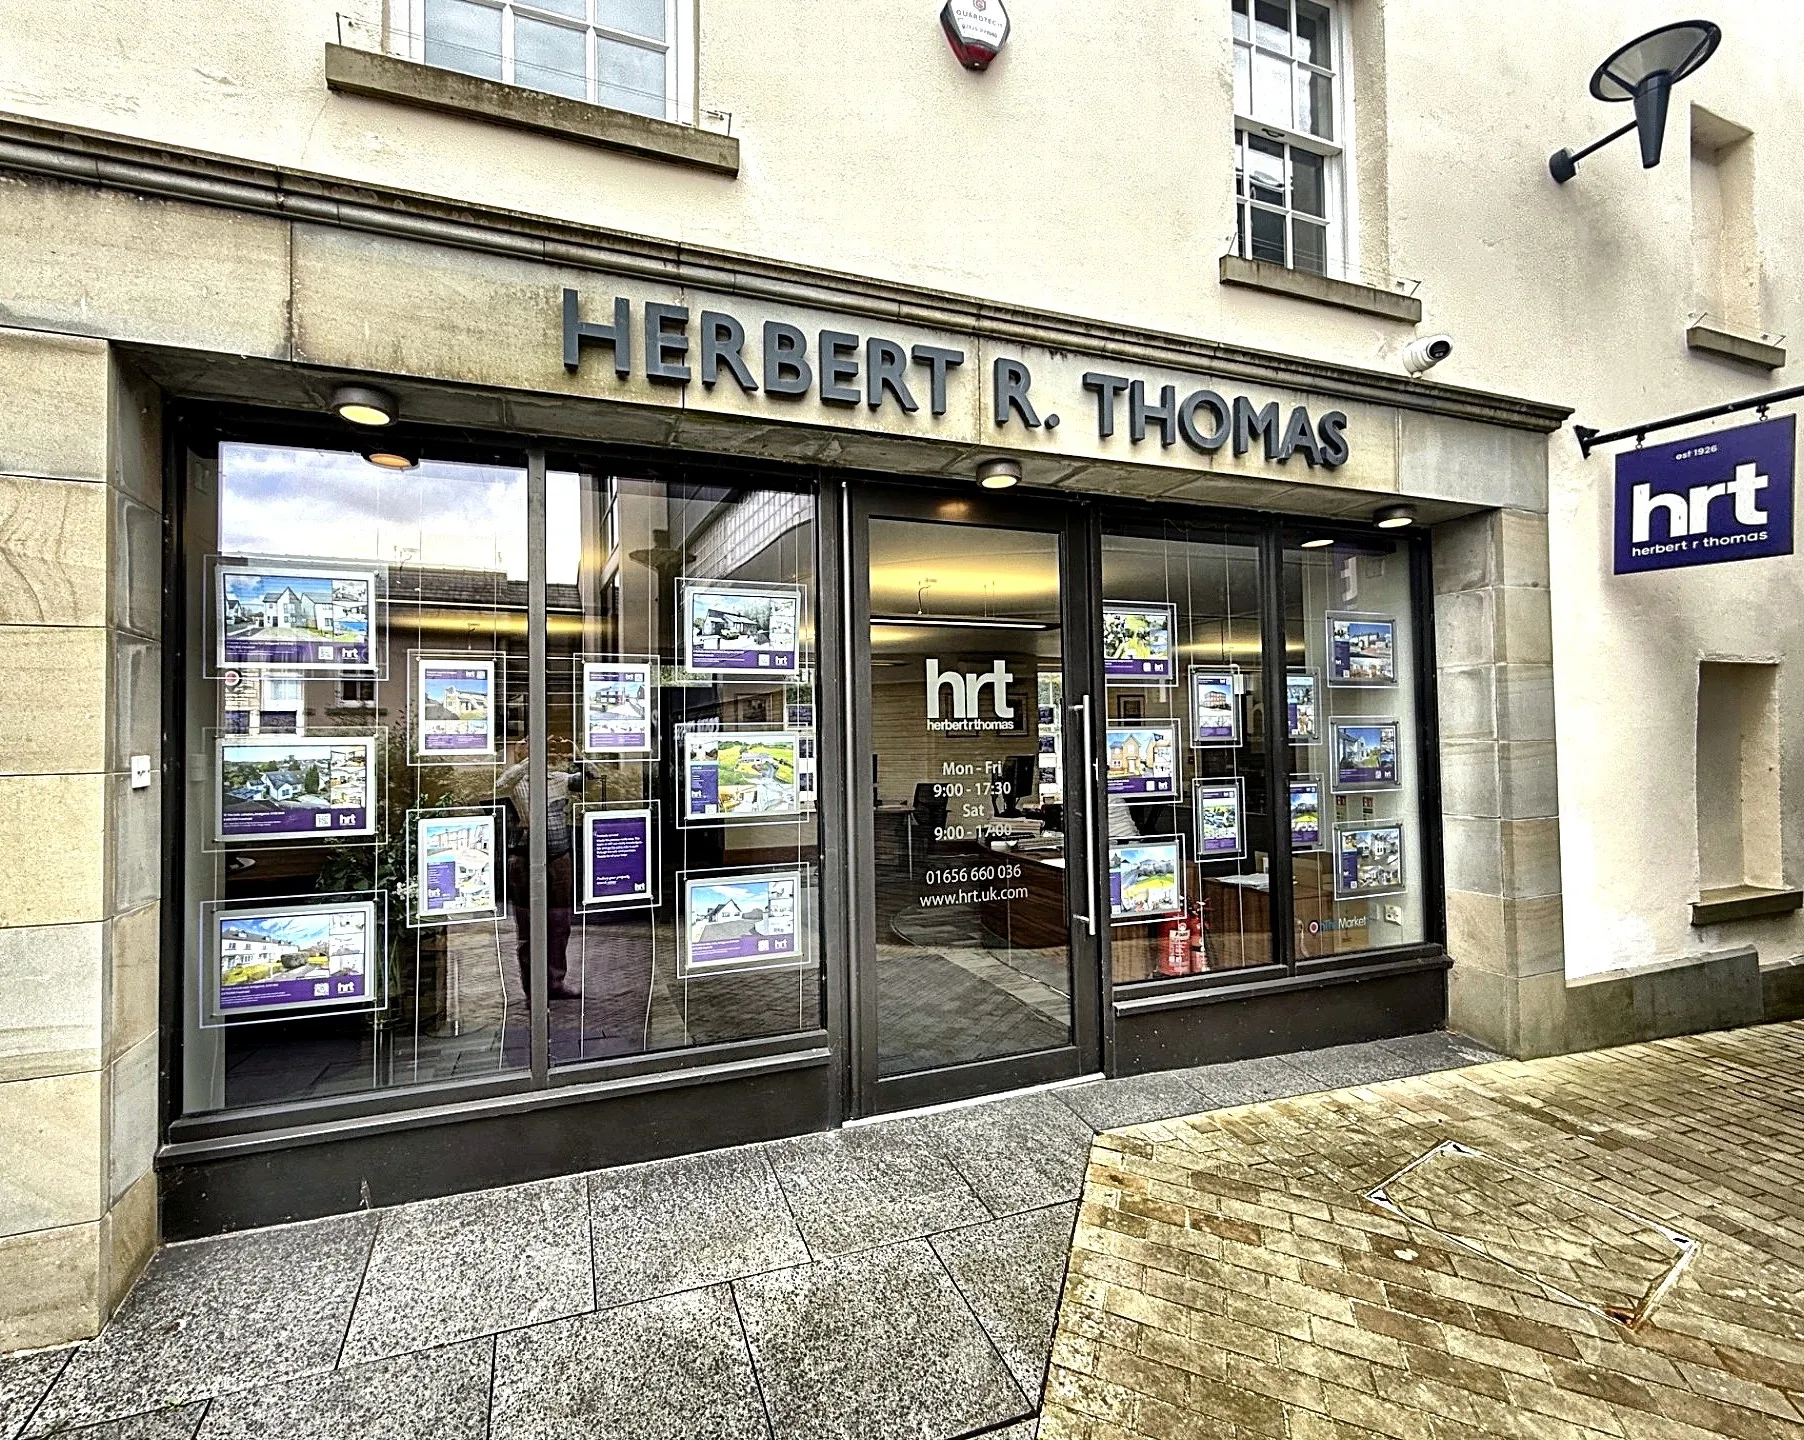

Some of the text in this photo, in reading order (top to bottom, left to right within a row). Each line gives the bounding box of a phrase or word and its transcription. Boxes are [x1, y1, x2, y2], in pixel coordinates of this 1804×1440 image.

[562, 287, 1349, 469] HERBERT R. THOMAS
[1675, 444, 1718, 460] est 1926
[1632, 462, 1769, 543] hrt
[1632, 531, 1768, 557] herbert r thomas
[926, 658, 1014, 719] hrt
[942, 762, 974, 776] Mon
[985, 760, 1002, 776] Fri
[934, 783, 964, 798] 9:00
[976, 782, 1012, 796] 17:30
[340, 814, 356, 824] hrt
[962, 804, 984, 818] Sat
[934, 826, 964, 841] 9:00
[976, 823, 1012, 838] 17:00
[926, 864, 1022, 885] 01656 660 036
[920, 886, 1028, 907] www.hrt.uk.com
[337, 981, 354, 993] hrt
